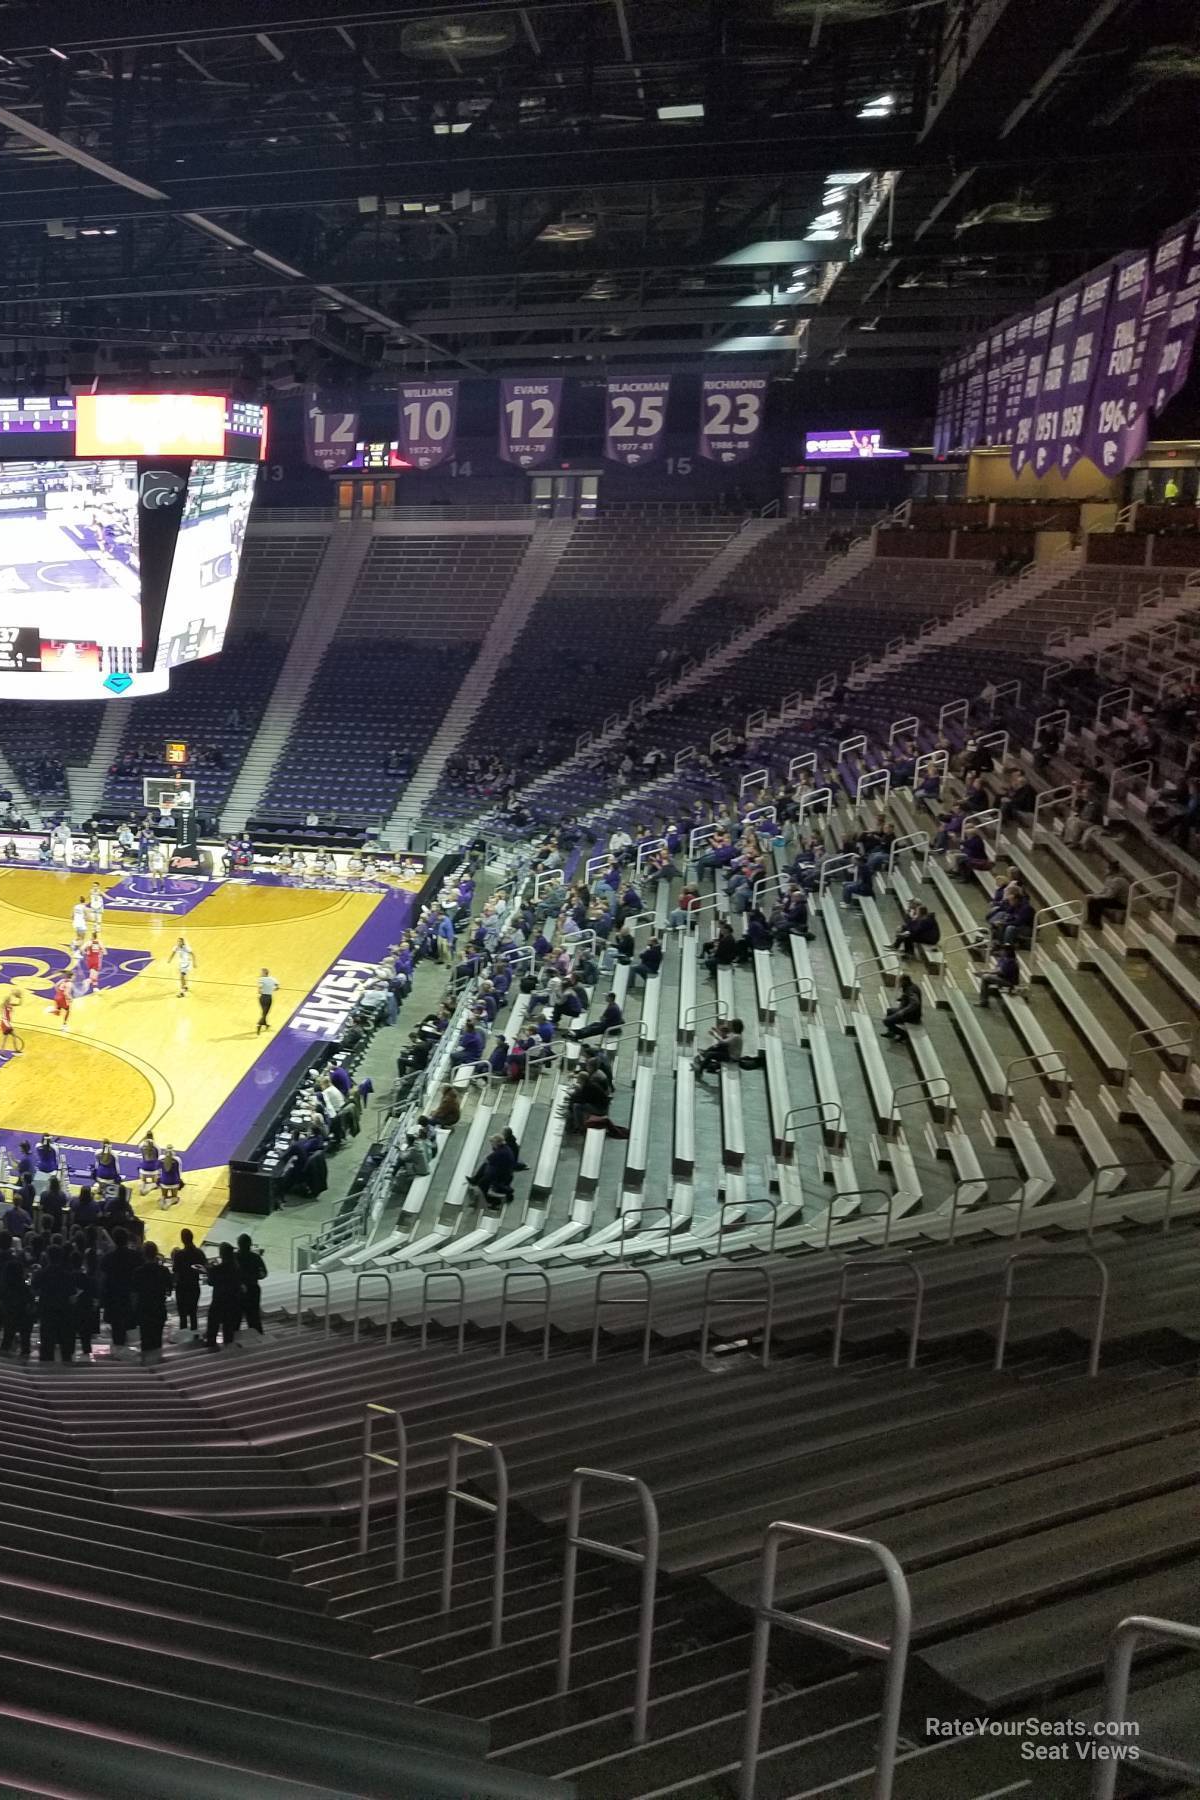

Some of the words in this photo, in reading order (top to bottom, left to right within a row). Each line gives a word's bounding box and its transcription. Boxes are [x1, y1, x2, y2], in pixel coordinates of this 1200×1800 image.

[403, 388, 454, 399] WILLIAMS
[513, 385, 550, 395] EVANS
[608, 382, 669, 393] BLACKMAN
[704, 380, 766, 390] RICHMOND
[403, 401, 450, 440] 10
[506, 399, 554, 438] 12
[608, 397, 663, 437] 25
[703, 394, 760, 435] 23
[1098, 399, 1127, 434] 196
[451, 462, 472, 477] 14
[666, 457, 692, 475] 15
[288, 959, 382, 1036] K-STATE
